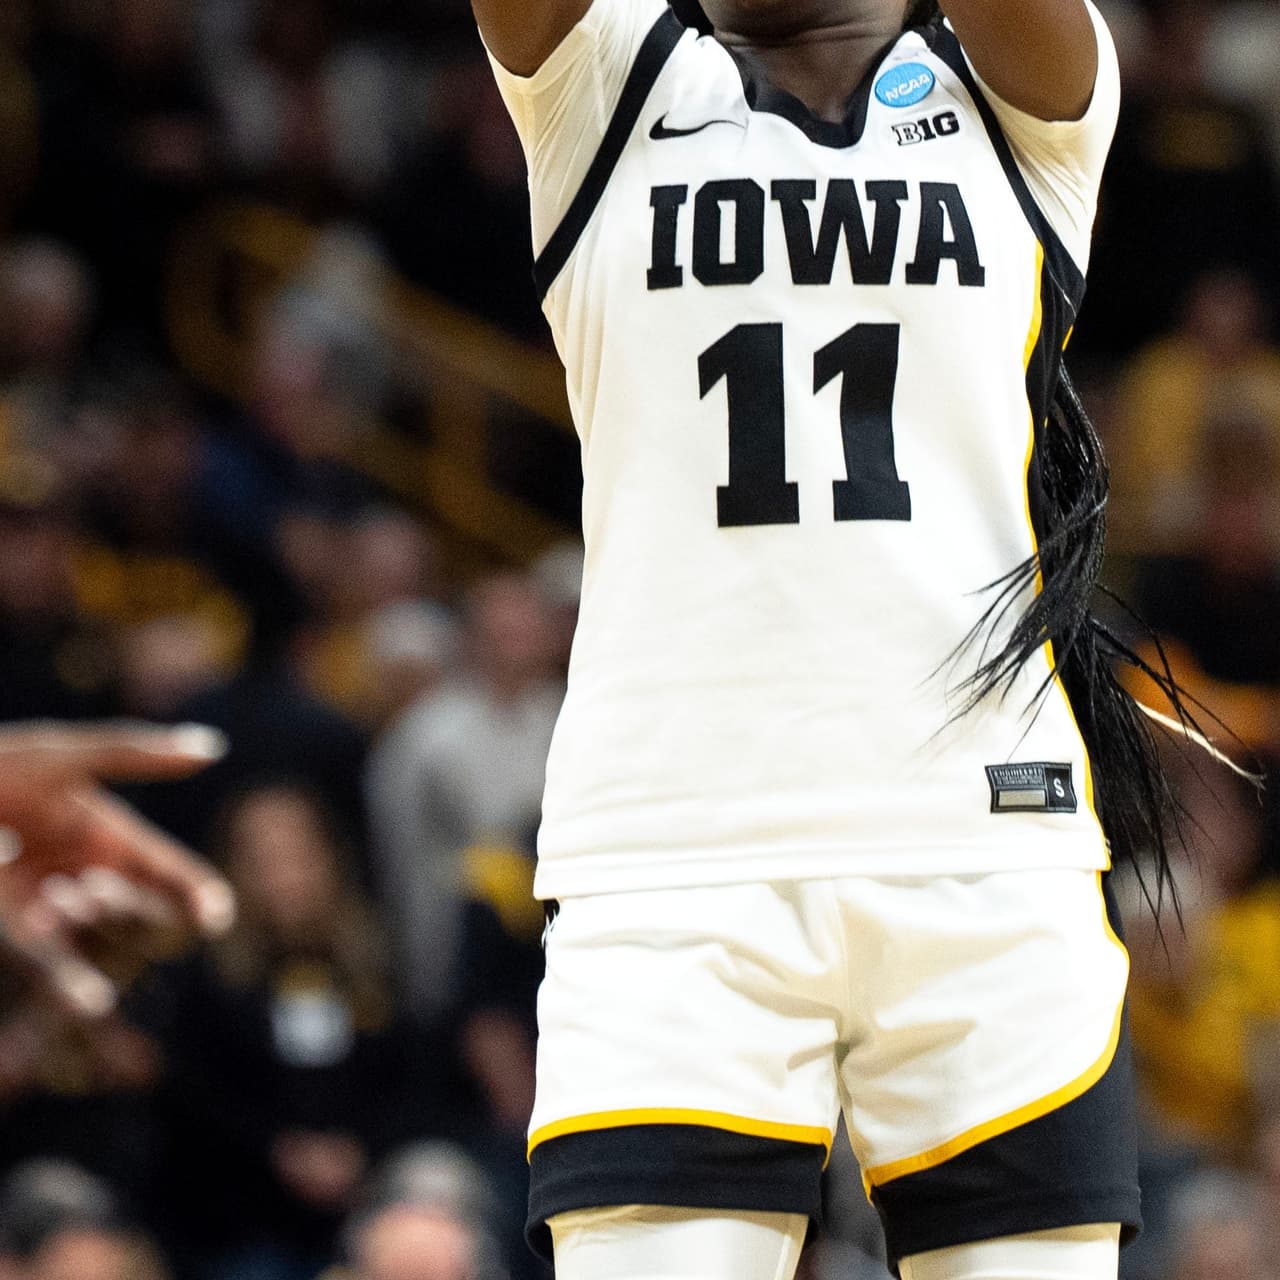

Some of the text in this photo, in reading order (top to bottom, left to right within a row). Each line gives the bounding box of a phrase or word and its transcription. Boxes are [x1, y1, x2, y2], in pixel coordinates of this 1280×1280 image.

[884, 73, 932, 102] NCAA
[646, 177, 986, 291] IOWA
[697, 322, 912, 528] 11
[1053, 777, 1065, 798] S
